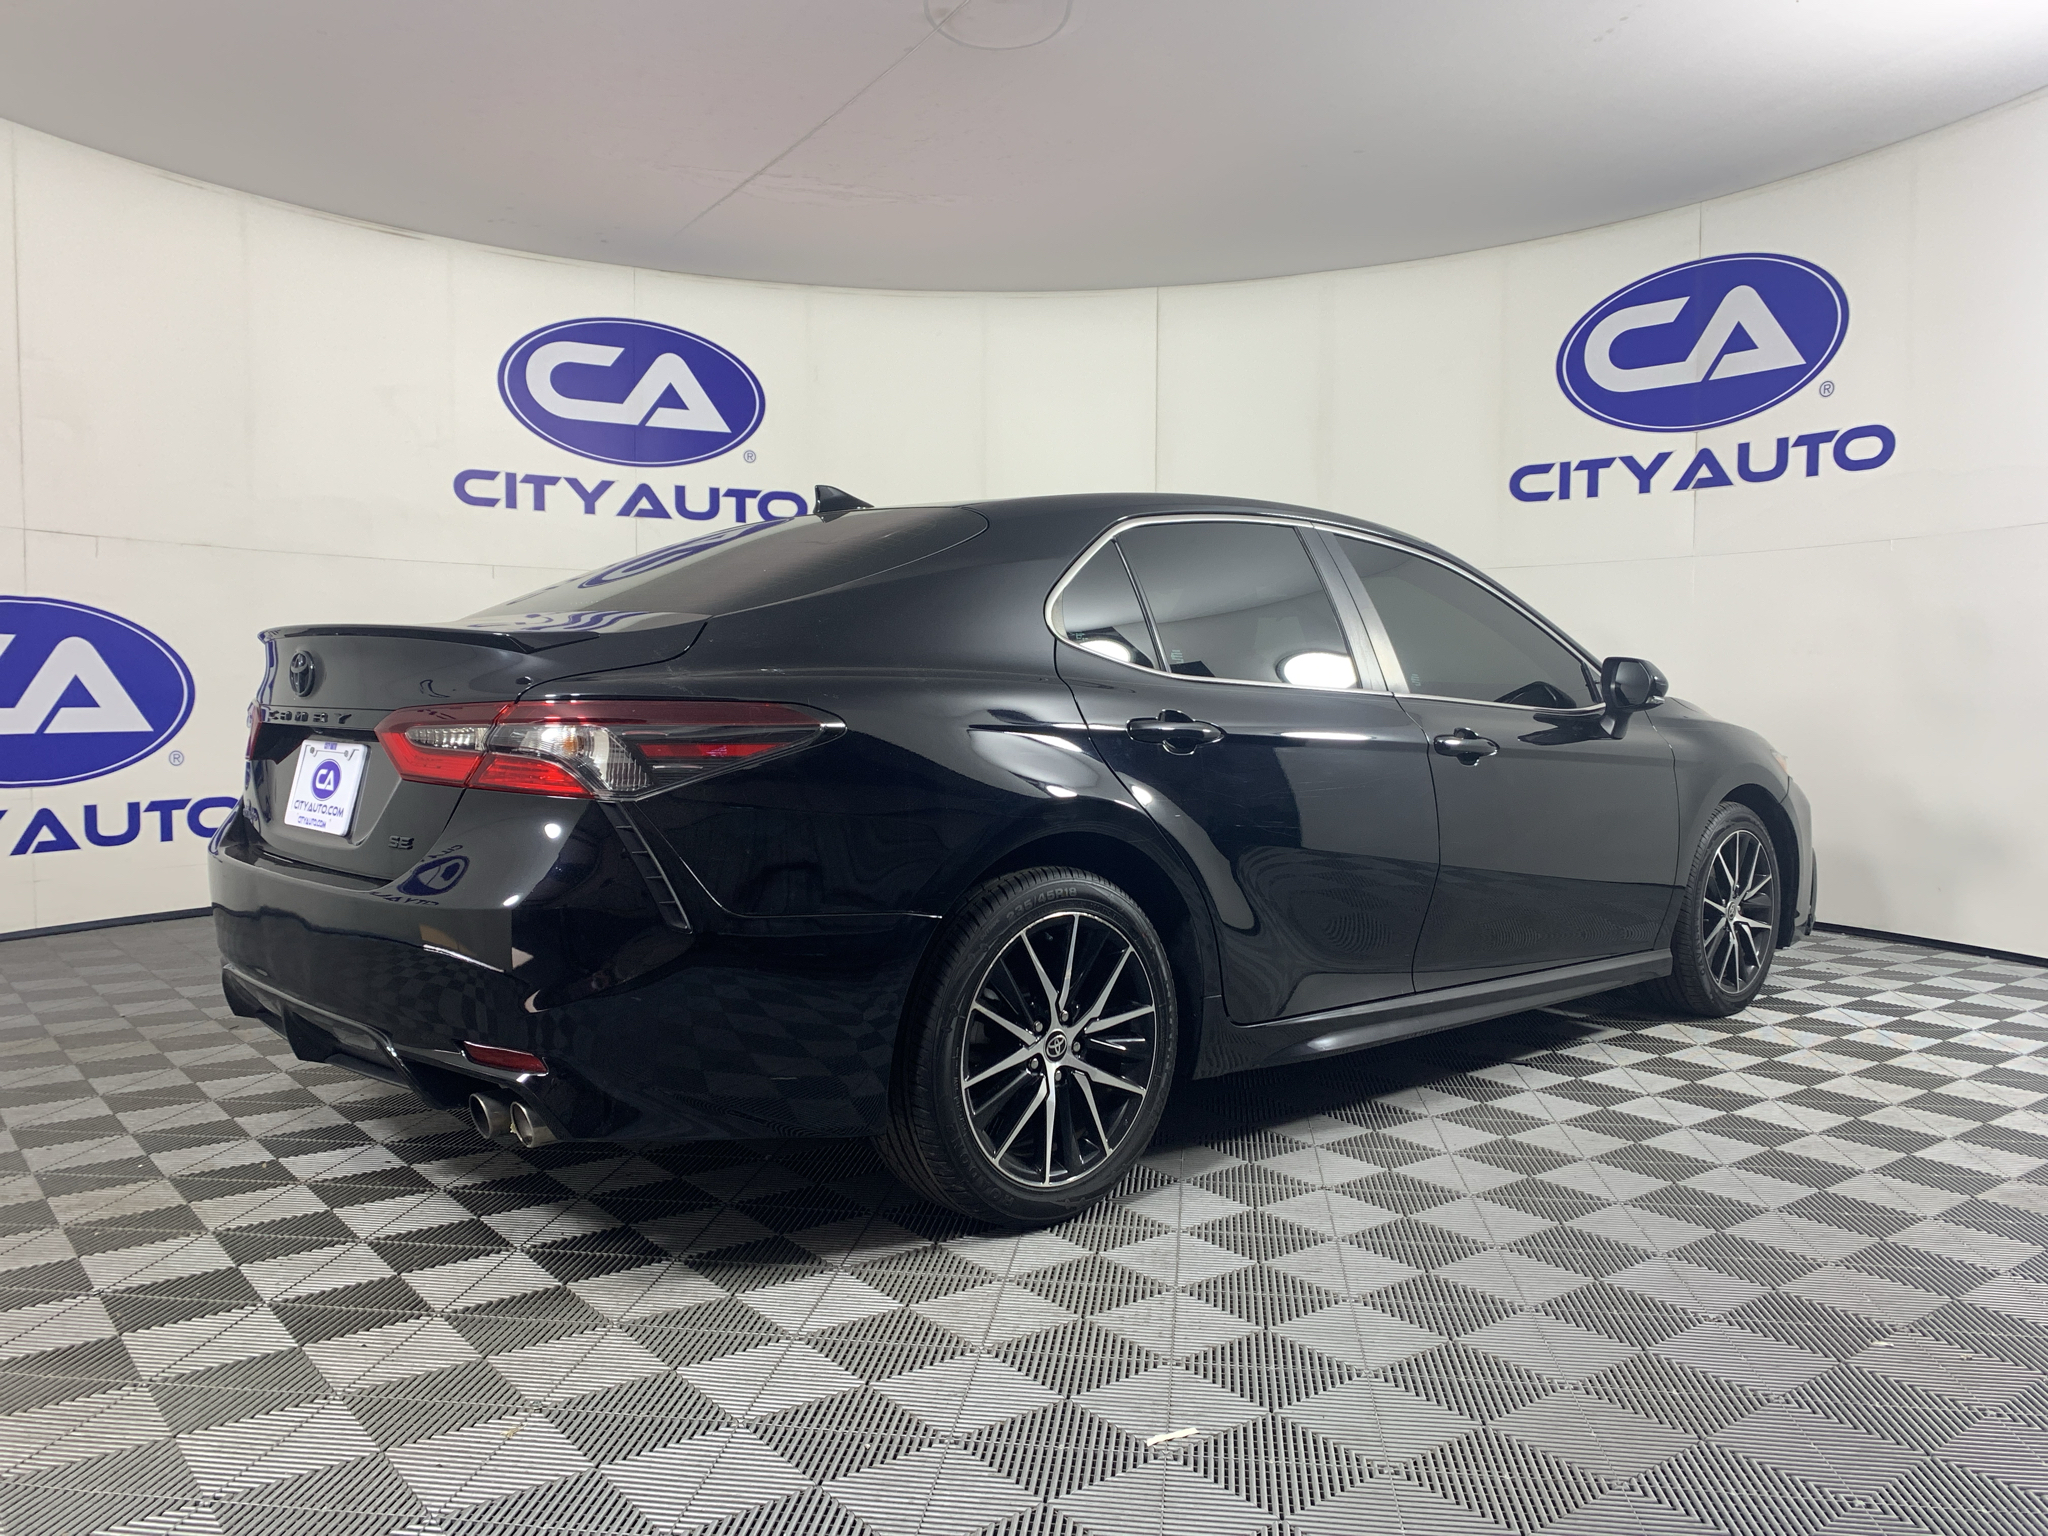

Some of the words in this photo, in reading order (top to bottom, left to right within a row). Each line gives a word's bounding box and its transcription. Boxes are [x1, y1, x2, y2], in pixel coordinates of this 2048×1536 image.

[1583, 284, 1807, 393] CA
[525, 340, 732, 433] CA
[315, 769, 335, 791] CA
[388, 835, 415, 850] SE
